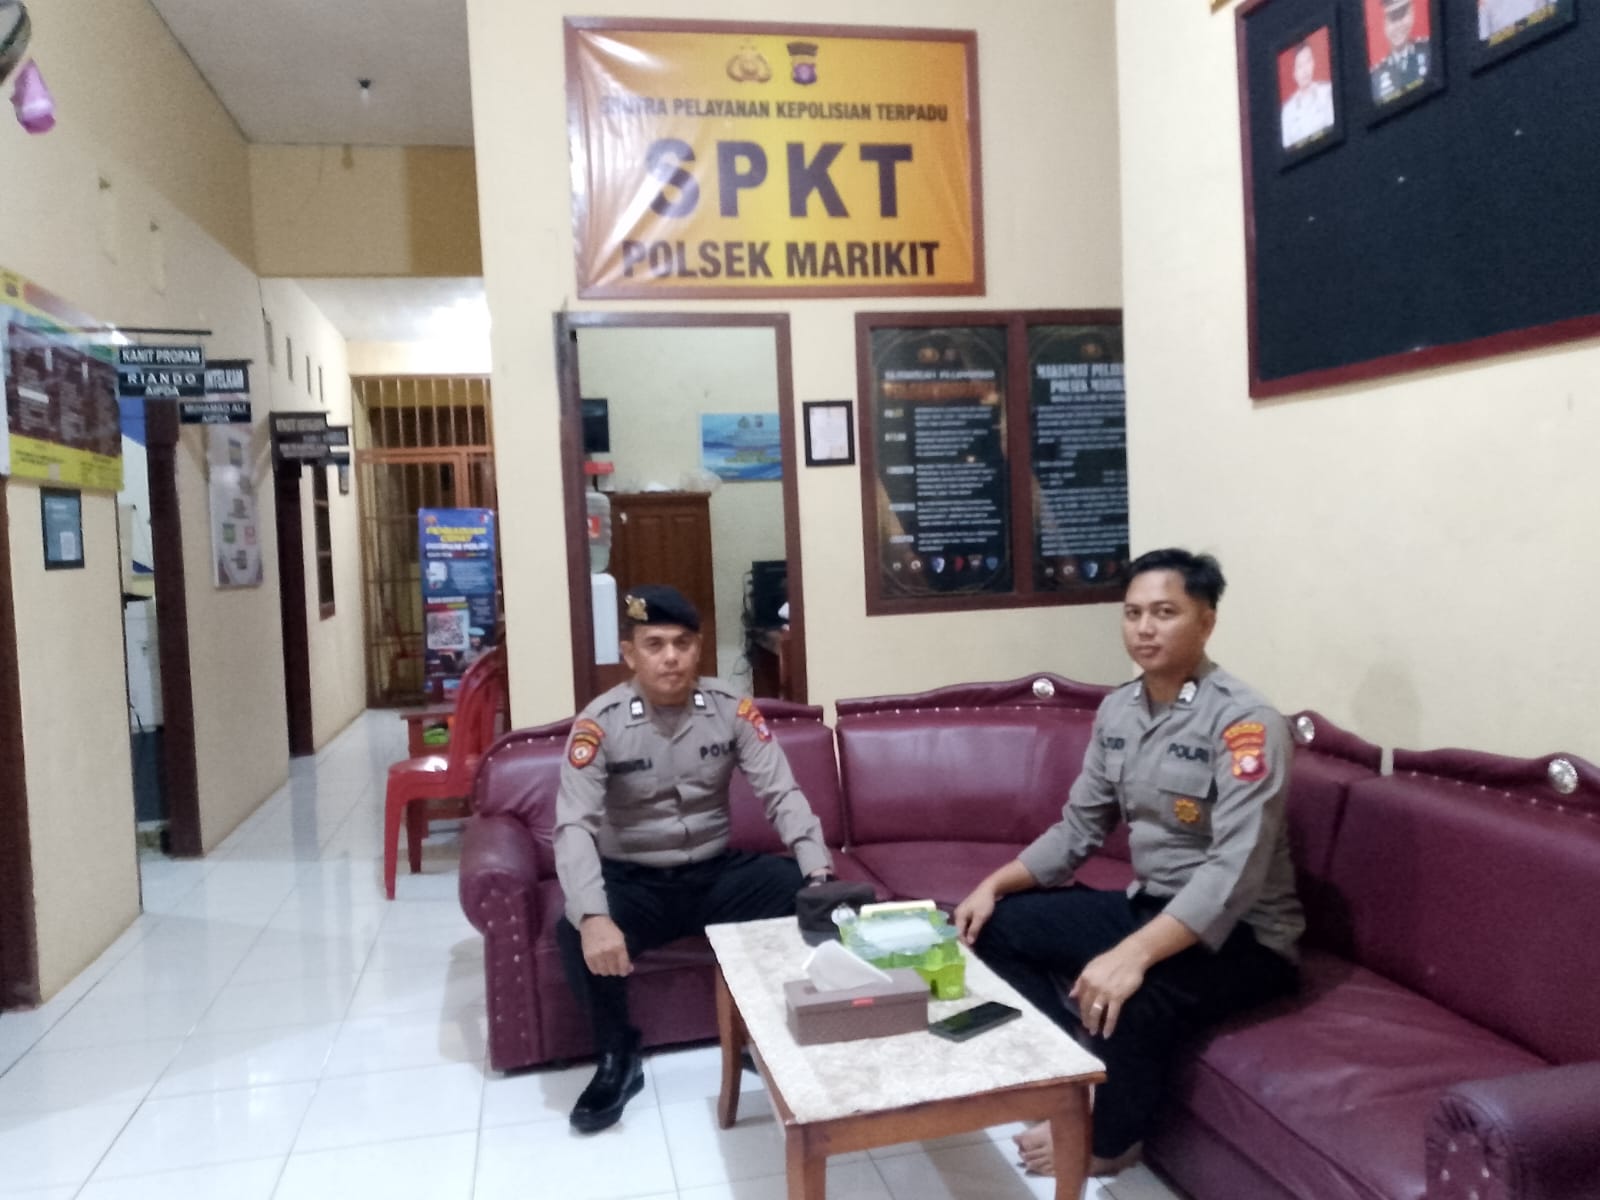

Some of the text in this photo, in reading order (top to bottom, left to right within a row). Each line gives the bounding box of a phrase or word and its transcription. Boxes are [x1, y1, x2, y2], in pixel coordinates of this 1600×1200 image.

[601, 95, 948, 122] SNTRA PELAYANAN KEPOLISIAN TERPADU
[645, 138, 913, 218] SPKT
[622, 239, 940, 278] POLSEK MARIKIT
[156, 349, 200, 362] PROPAM
[127, 371, 197, 385] RIANDO
